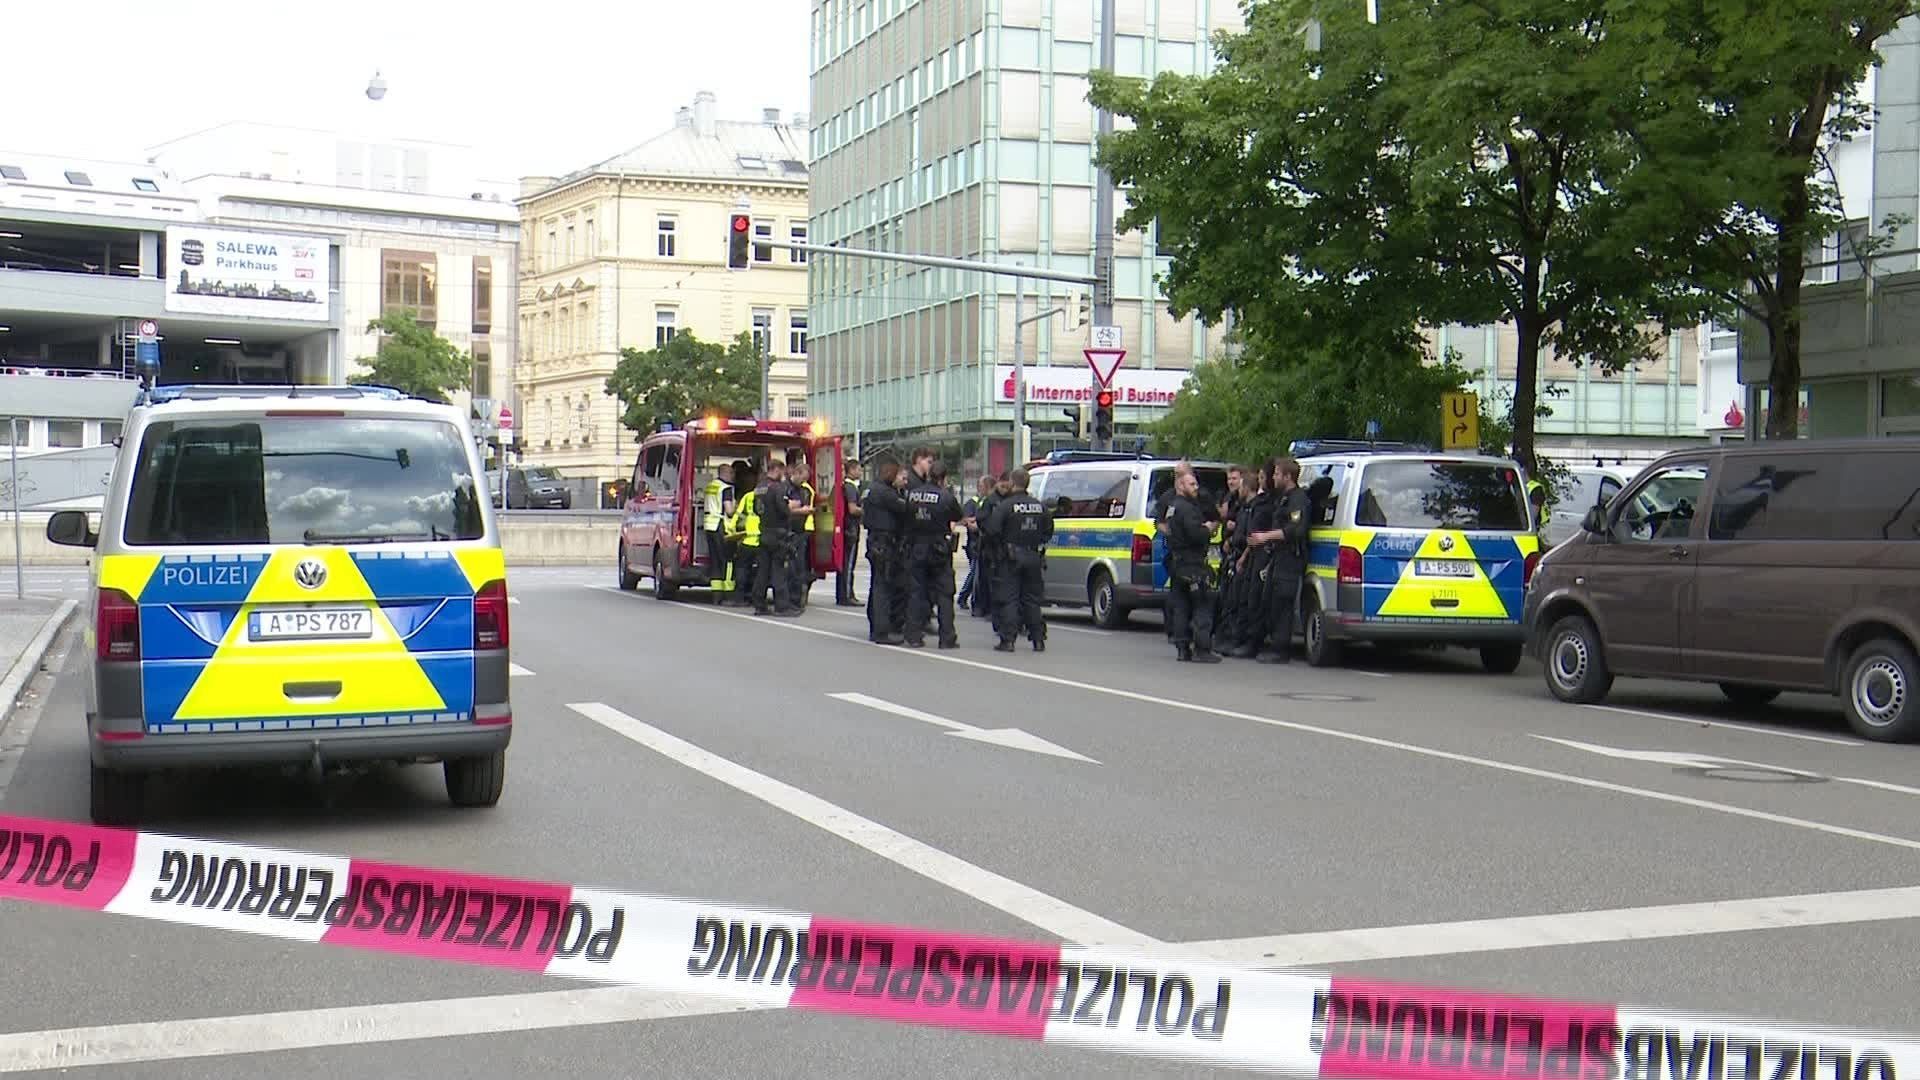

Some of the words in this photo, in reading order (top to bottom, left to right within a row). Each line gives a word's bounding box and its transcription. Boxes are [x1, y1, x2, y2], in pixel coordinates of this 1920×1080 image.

[217, 241, 278, 256] SALEWA
[217, 257, 278, 271] Parkhaus
[1032, 385, 1122, 401] Internatial
[1128, 387, 1177, 403] Busine
[1453, 399, 1467, 418] U
[909, 492, 939, 503] POLIZEI
[1014, 503, 1043, 514] POLIZEI
[1374, 539, 1416, 552] POLIZEI
[164, 566, 248, 586] POLIZEI
[326, 613, 363, 631] 787
[150, 849, 625, 963] POLIZEIABSPERRUNG
[687, 913, 1231, 1041] POLIZEIABSPERRUNG
